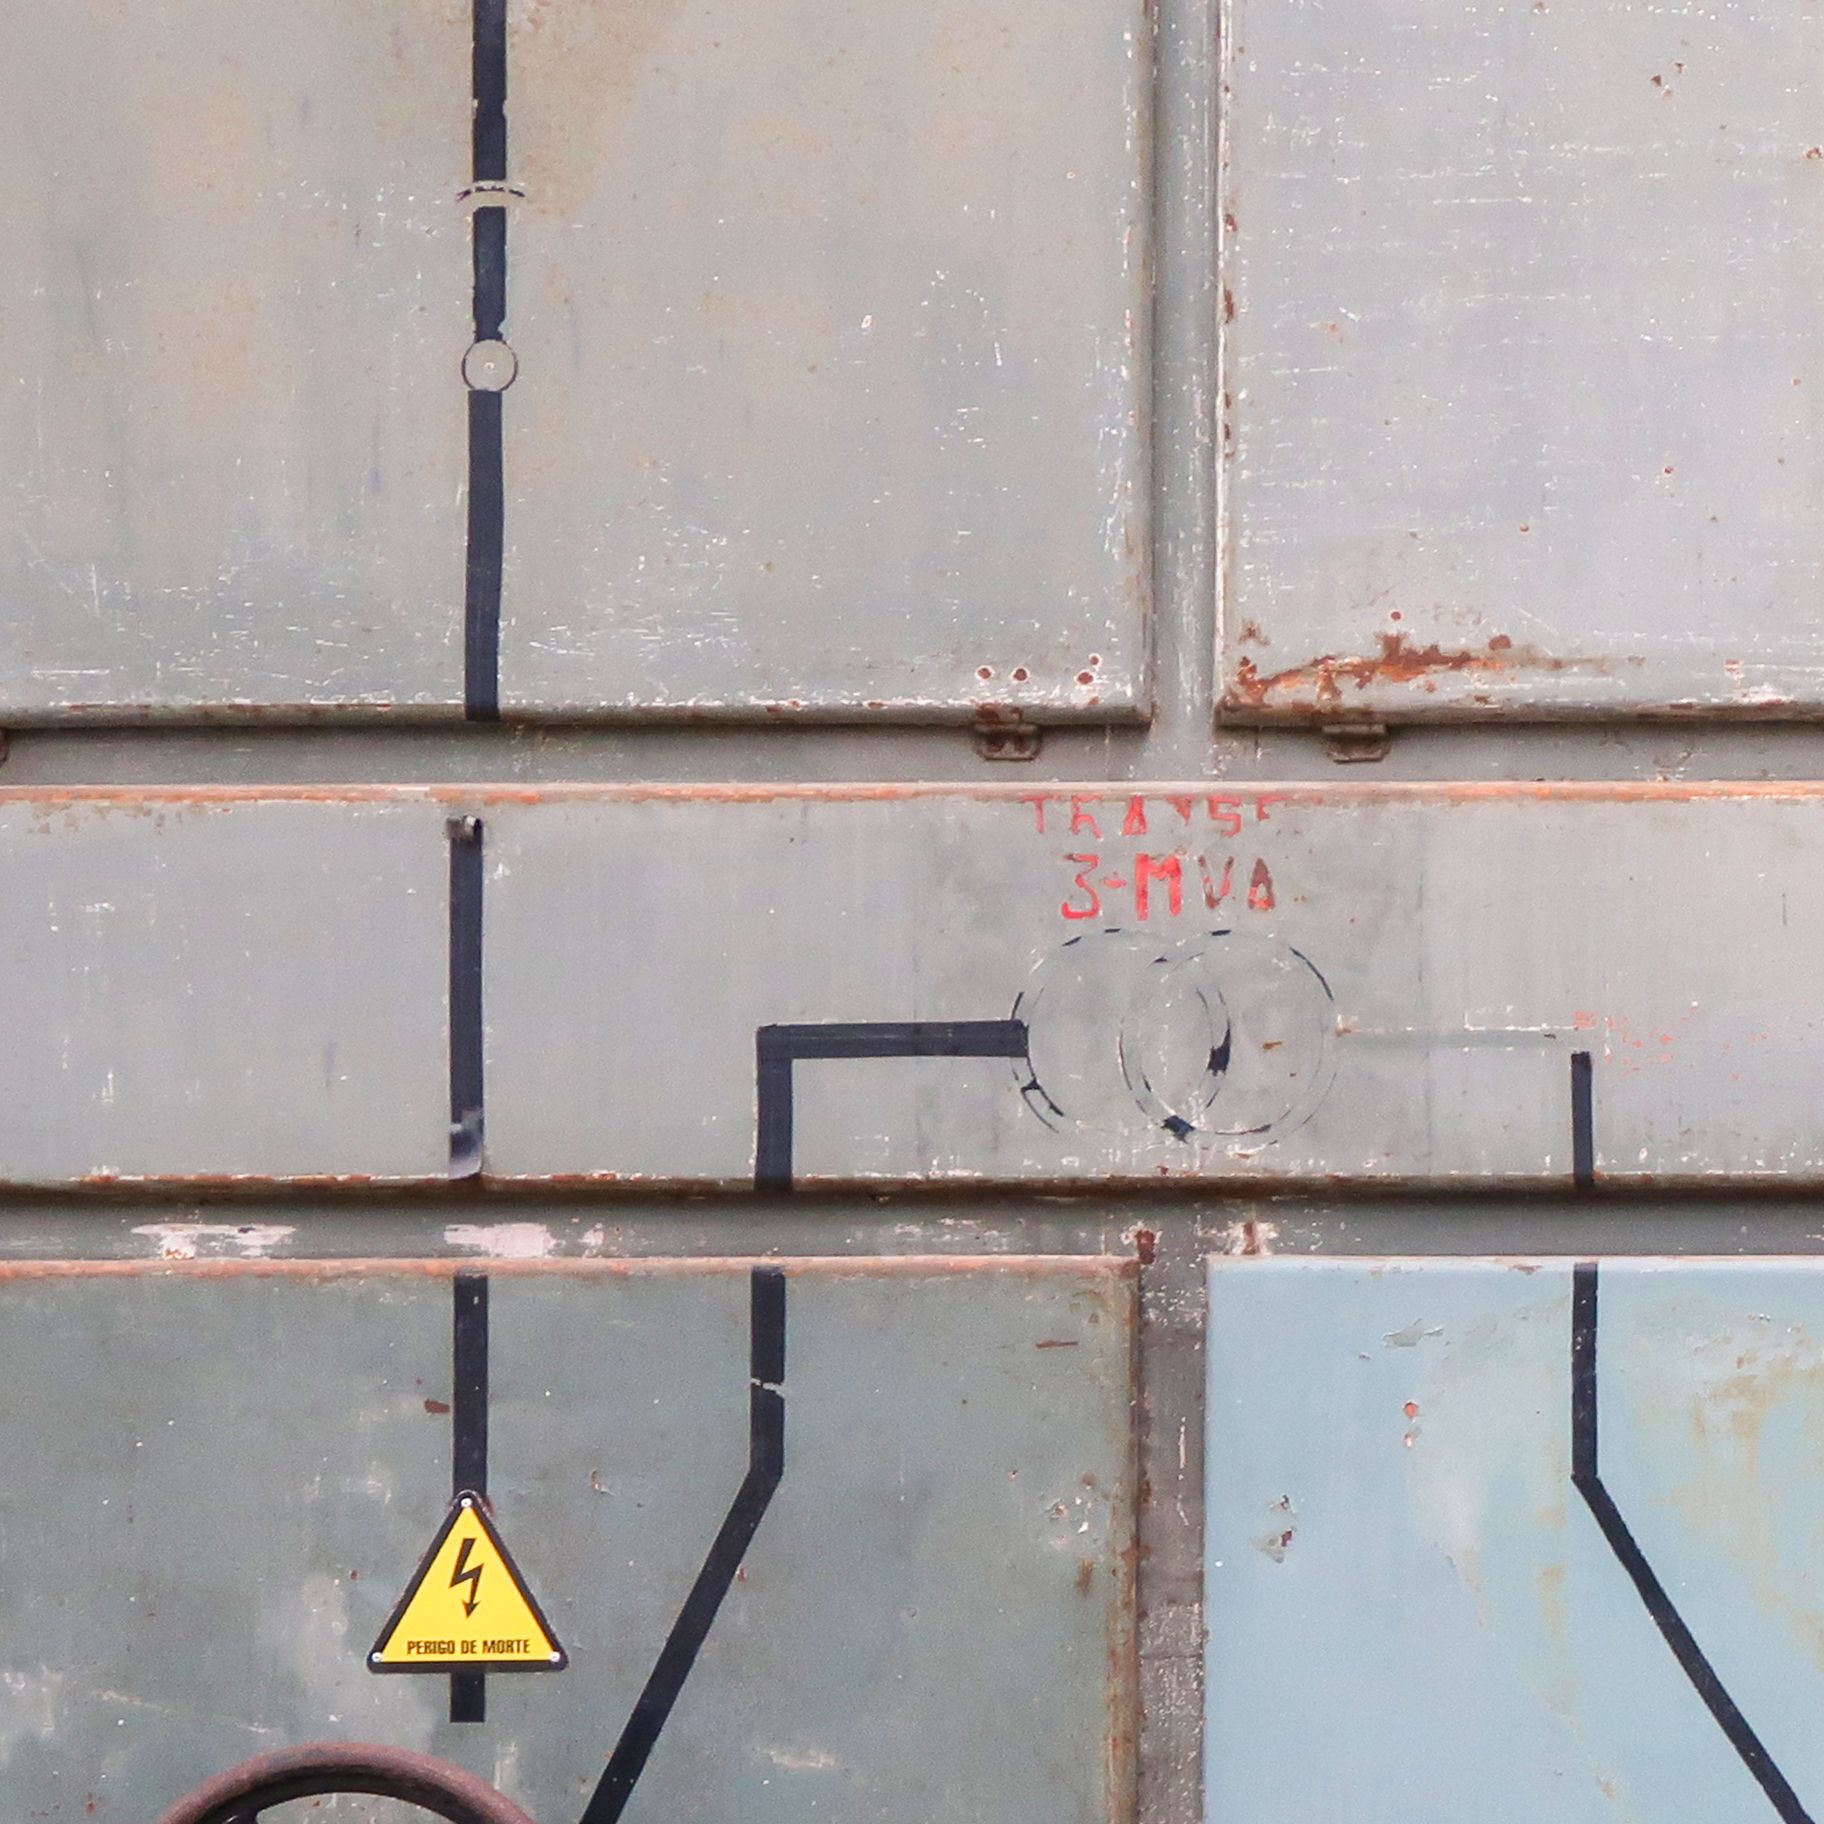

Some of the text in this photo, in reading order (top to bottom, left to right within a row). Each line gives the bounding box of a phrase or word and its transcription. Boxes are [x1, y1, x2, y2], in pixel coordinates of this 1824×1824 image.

[406, 1639, 531, 1655] PERIGO DE MORTE
